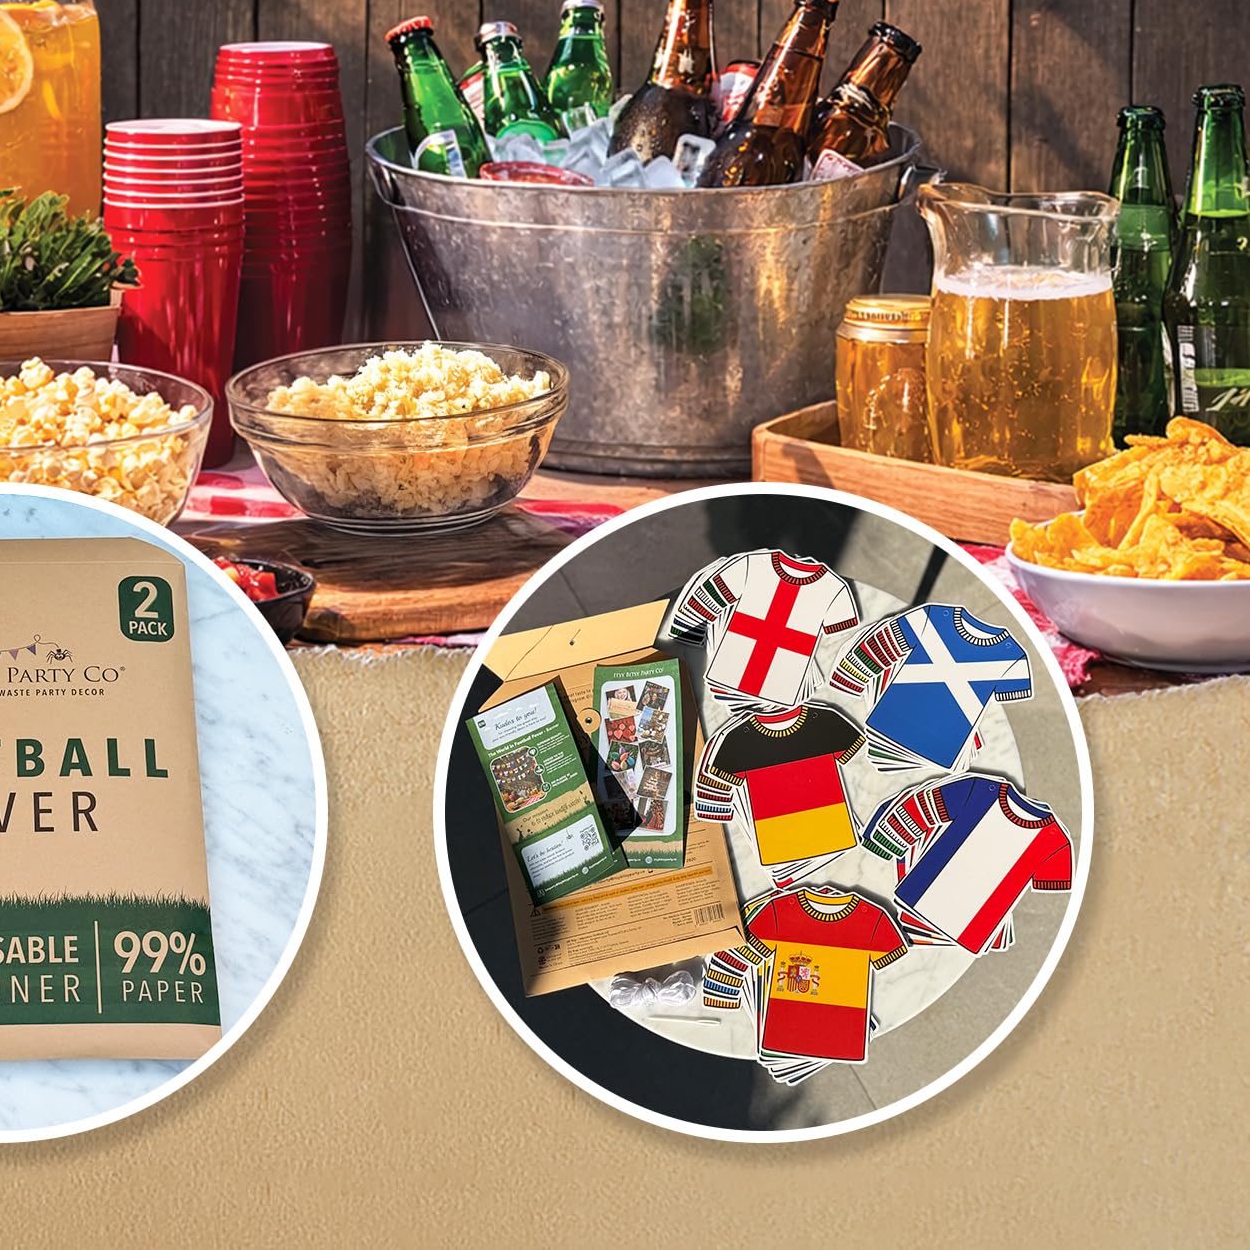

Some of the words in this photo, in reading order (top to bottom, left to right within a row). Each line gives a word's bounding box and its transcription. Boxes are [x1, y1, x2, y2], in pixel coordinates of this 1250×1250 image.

[133, 581, 159, 618] 2
[129, 621, 168, 636] PACK
[35, 688, 66, 697] PARTY
[71, 688, 105, 696] DECOR
[114, 930, 206, 976] 99%
[122, 980, 203, 1004] PAPER
